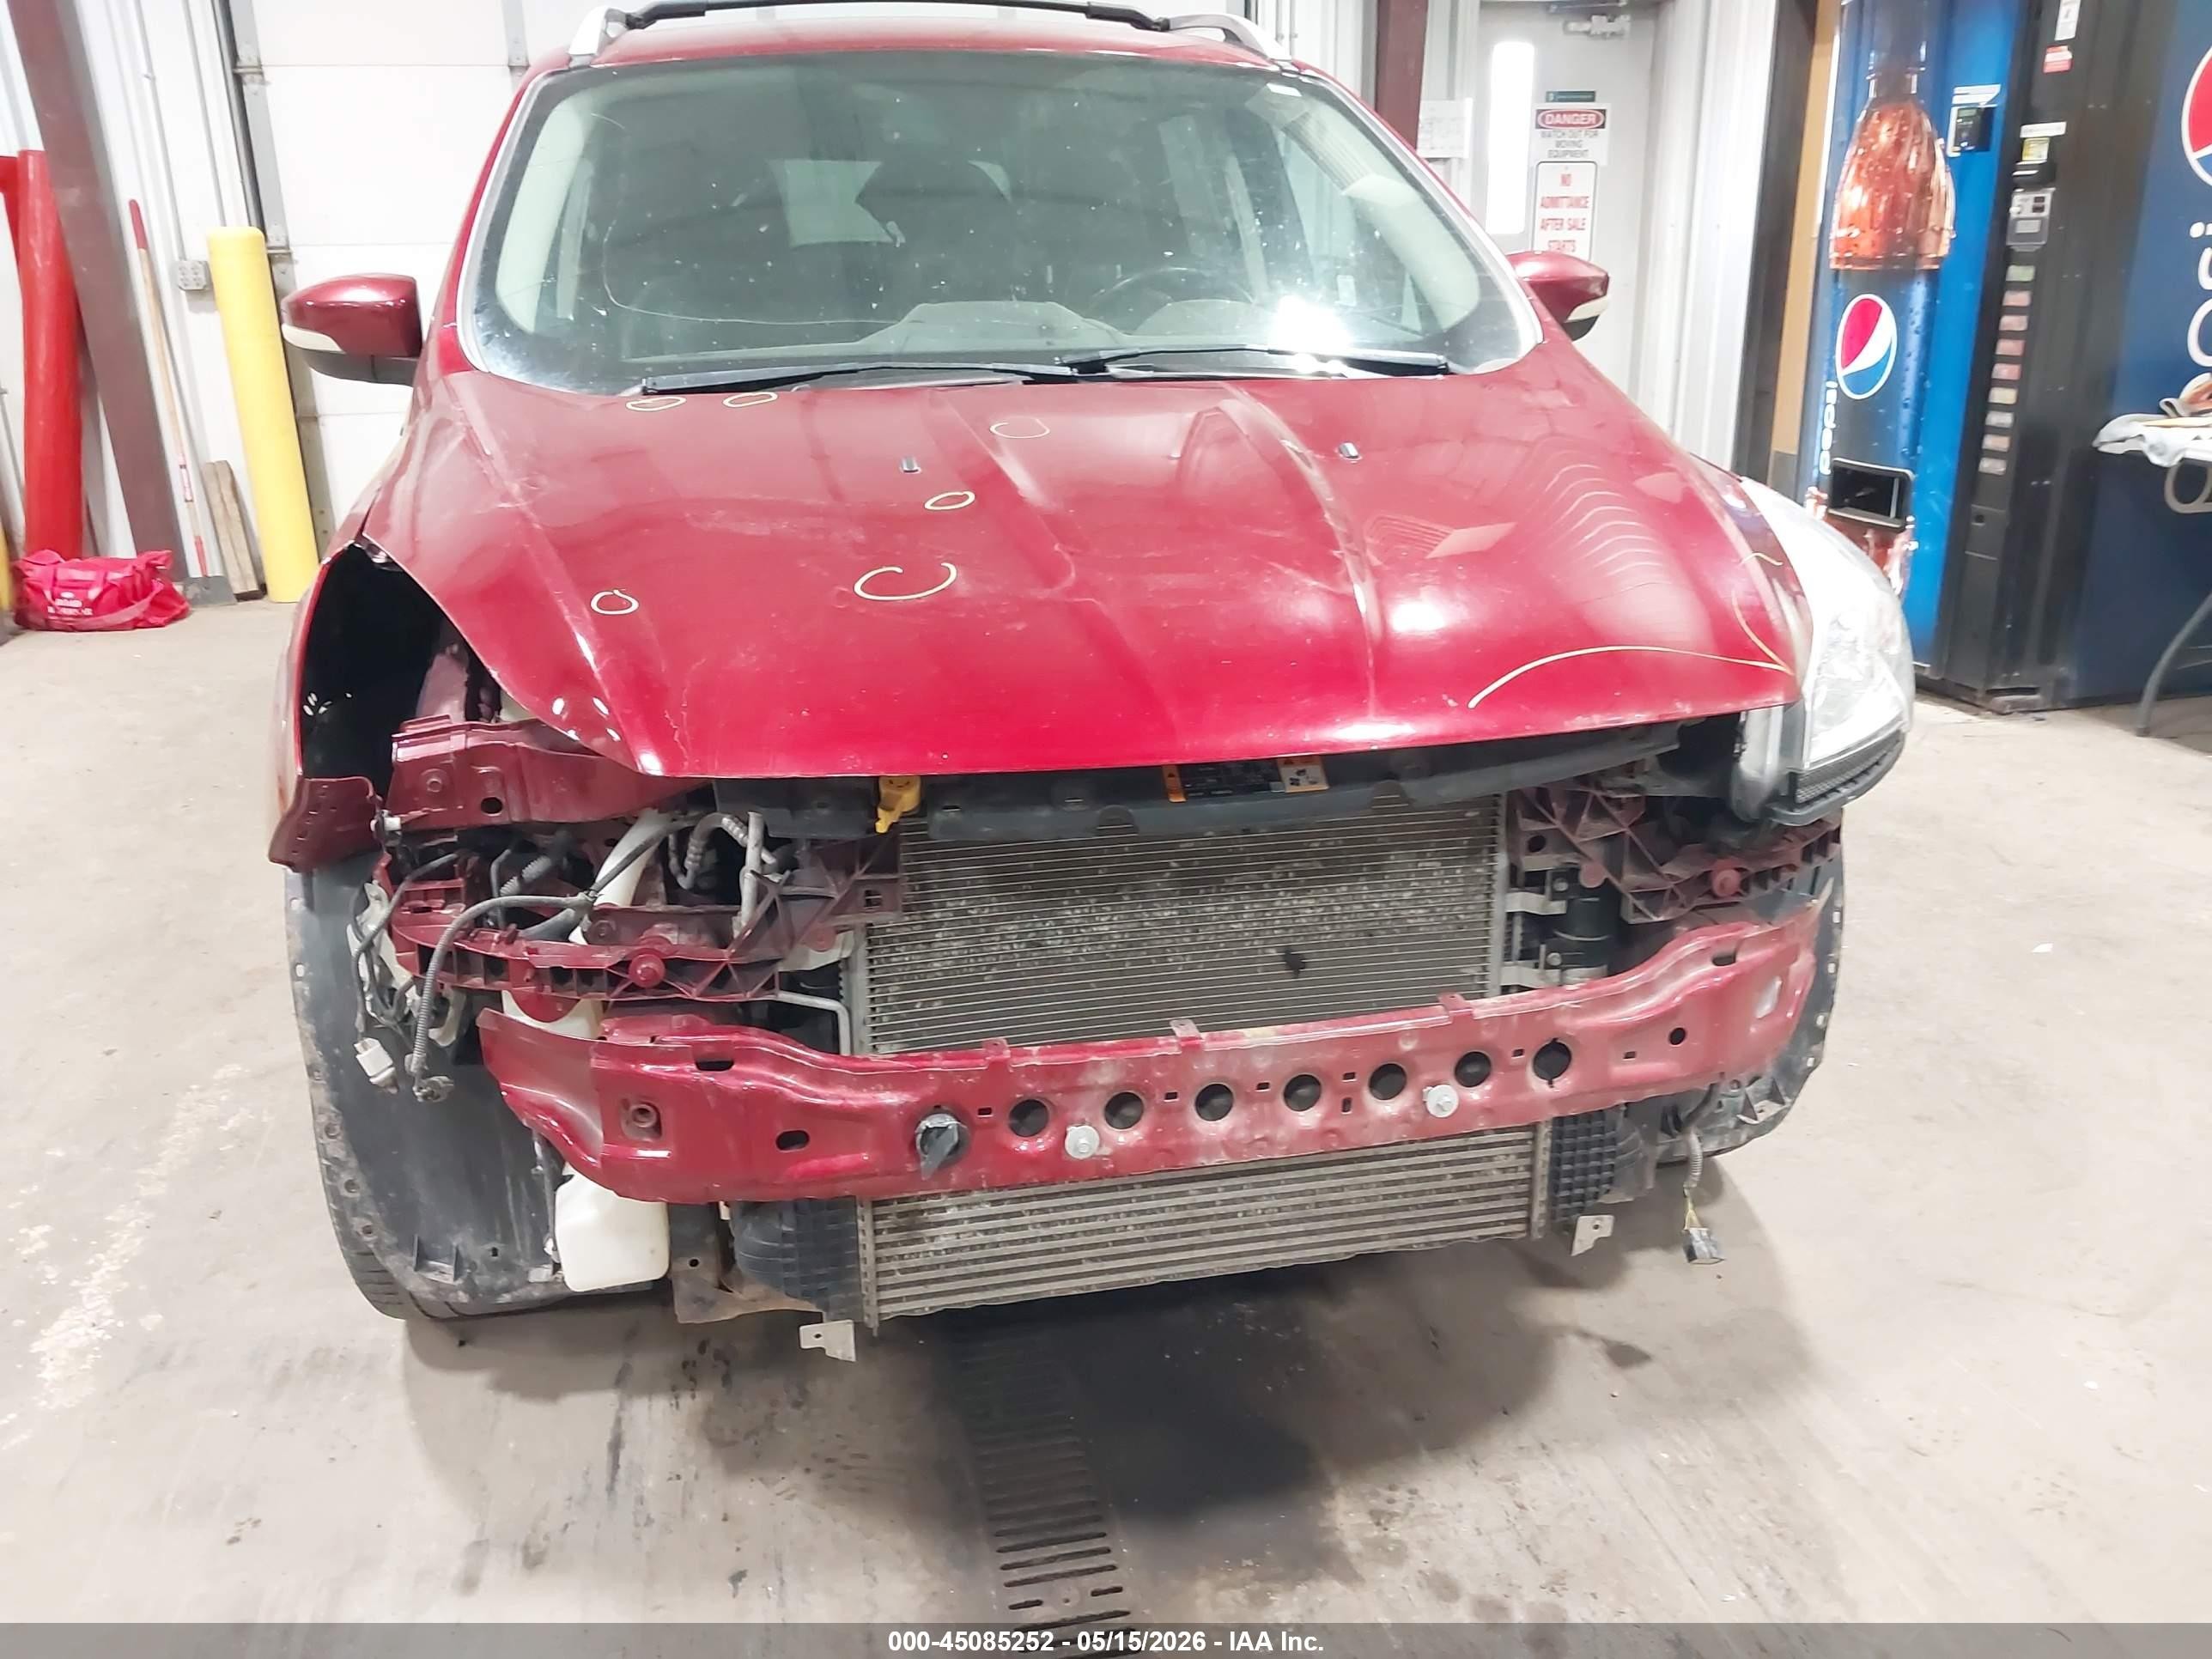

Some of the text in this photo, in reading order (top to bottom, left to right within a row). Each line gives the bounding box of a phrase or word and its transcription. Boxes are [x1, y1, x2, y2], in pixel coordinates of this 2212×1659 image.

[1545, 112, 1597, 125] DANGER
[1555, 139, 1583, 149] MOVING
[1547, 149, 1589, 159] EQUIPMENT
[1540, 195, 1589, 209] ADMITTANCE
[1540, 217, 1586, 230] AFTER SALE
[1819, 380, 1838, 476] pepsi
